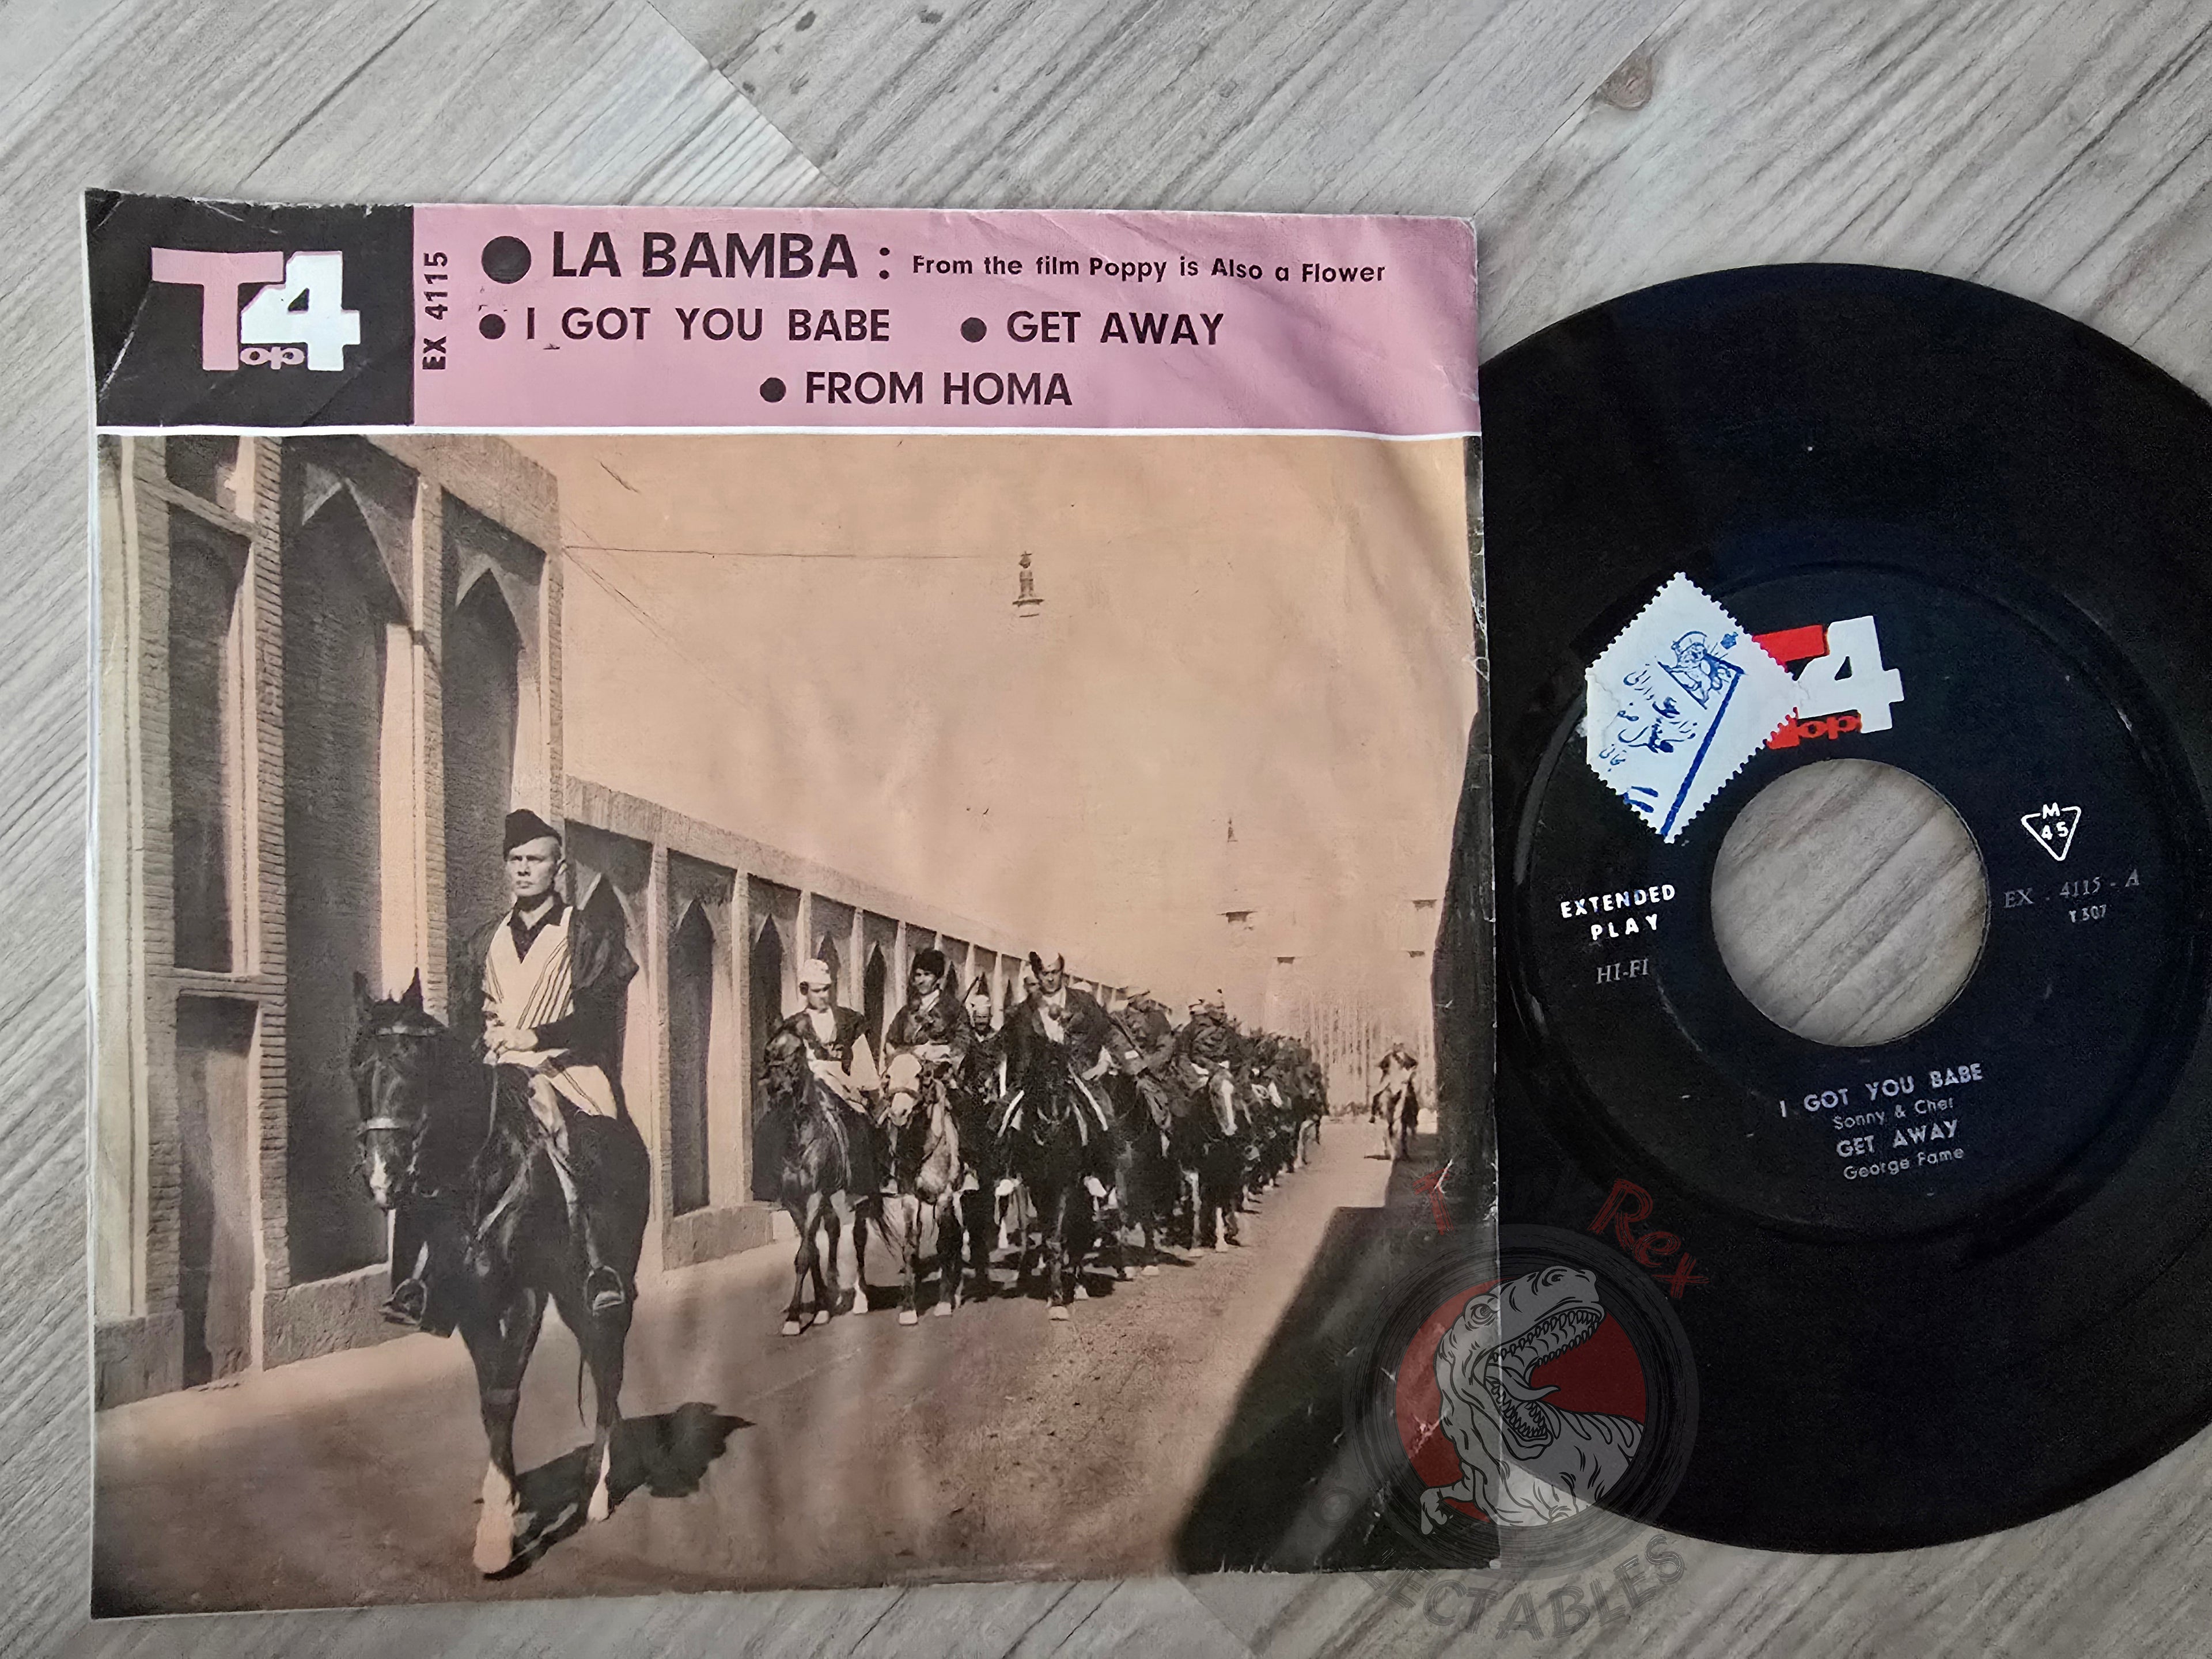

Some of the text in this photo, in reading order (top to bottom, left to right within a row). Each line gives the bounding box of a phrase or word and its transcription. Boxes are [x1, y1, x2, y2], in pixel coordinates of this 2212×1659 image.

[553, 232, 622, 277] LA
[642, 232, 858, 278] BAMBA
[913, 255, 973, 275] From
[984, 256, 1022, 275] the
[1036, 255, 1080, 275] film
[1089, 257, 1167, 283] Poppy
[1180, 255, 1198, 276] is
[1211, 257, 1263, 280] Also
[1275, 266, 1289, 282] a
[1302, 263, 1385, 283] Flower
[422, 252, 448, 370] EX 4115
[527, 307, 889, 342] I GOT YOU BABE
[1007, 310, 1224, 346] GET AWAY
[806, 371, 1073, 406] FROM HOMA
[2042, 802, 2061, 819] M
[1560, 884, 1675, 918] EXTENDED
[2004, 888, 2034, 908] EX
[2059, 876, 2101, 899] 4115
[2124, 868, 2140, 888] A
[1590, 914, 1658, 941] PLAY
[1596, 958, 1649, 984] HI-FI
[1779, 1063, 1983, 1118] I GOT YOU BABE
[1833, 1097, 1954, 1130] Sonny & Cher
[1836, 1119, 1959, 1157] GET AWAY
[1843, 1147, 1964, 1180] George Fame
